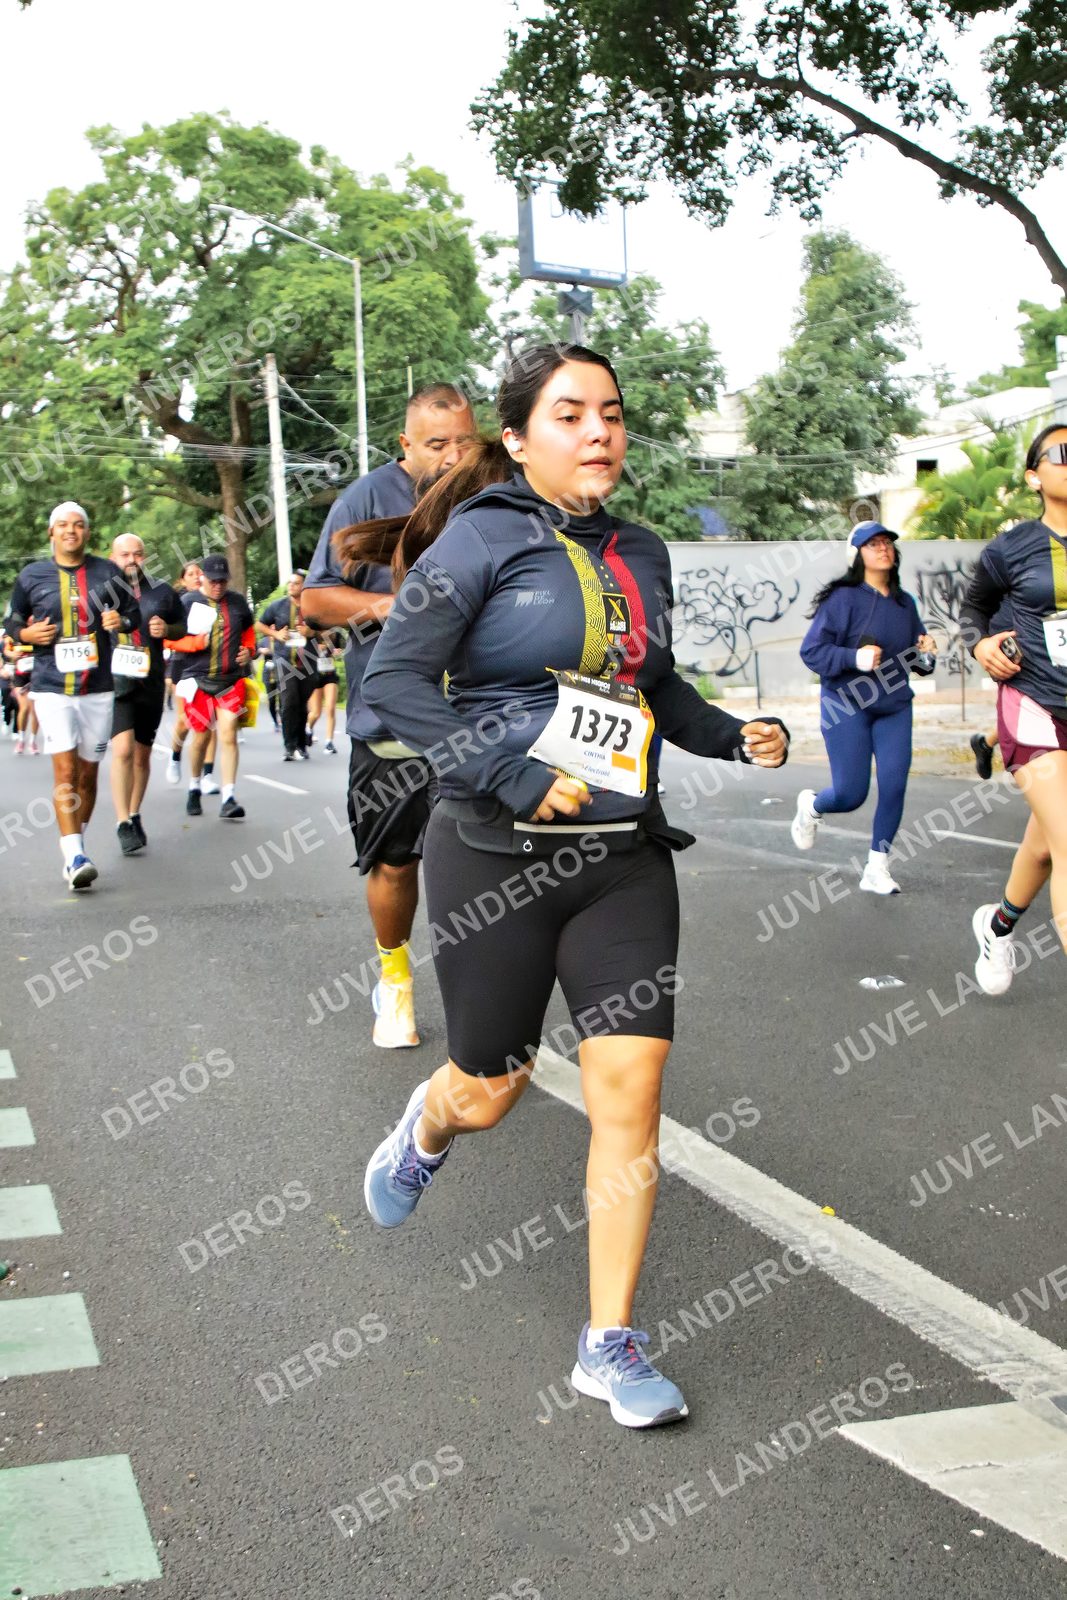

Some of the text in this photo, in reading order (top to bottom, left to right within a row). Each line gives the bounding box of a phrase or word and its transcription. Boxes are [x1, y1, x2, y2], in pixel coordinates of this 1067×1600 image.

[680, 565, 729, 584] TOY
[1056, 628, 1066, 647] 3
[62, 646, 90, 659] 7156
[119, 653, 143, 665] 7100
[570, 705, 632, 752] 1373
